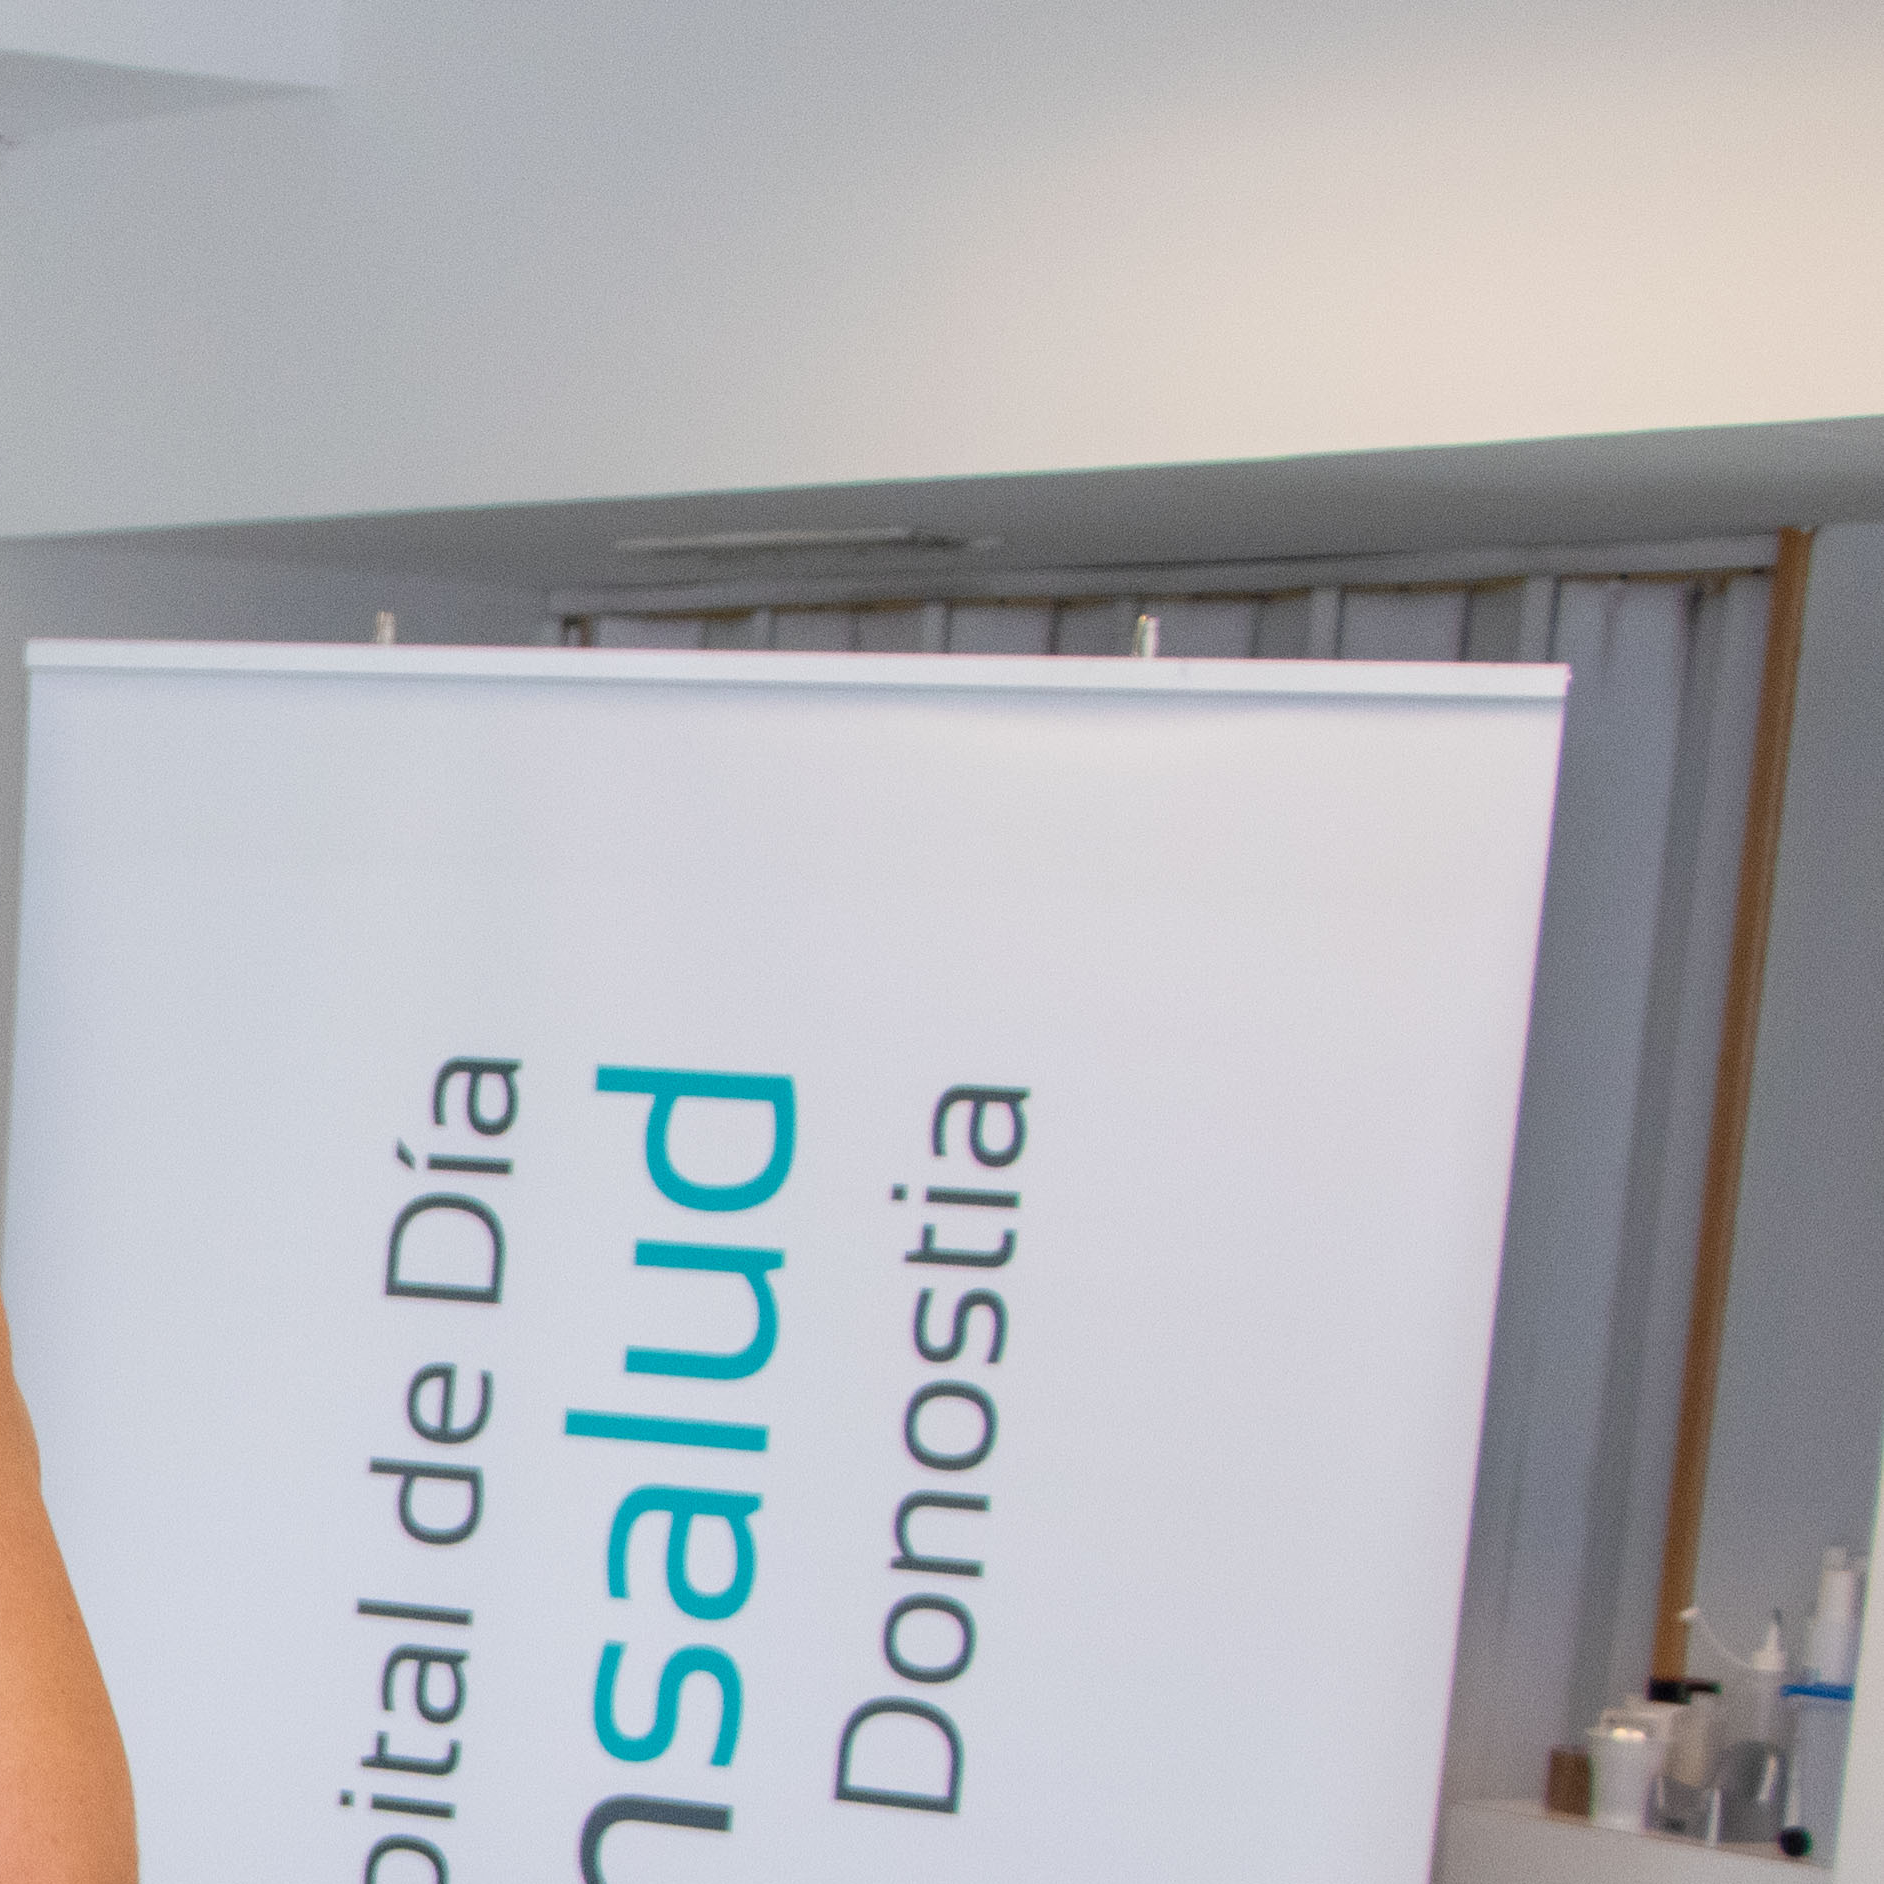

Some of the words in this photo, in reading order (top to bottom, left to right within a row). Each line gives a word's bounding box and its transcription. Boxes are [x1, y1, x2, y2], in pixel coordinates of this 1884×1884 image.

[384, 1054, 523, 1311] Día
[369, 1361, 492, 1549] de
[833, 1080, 1032, 1815] Donostia
